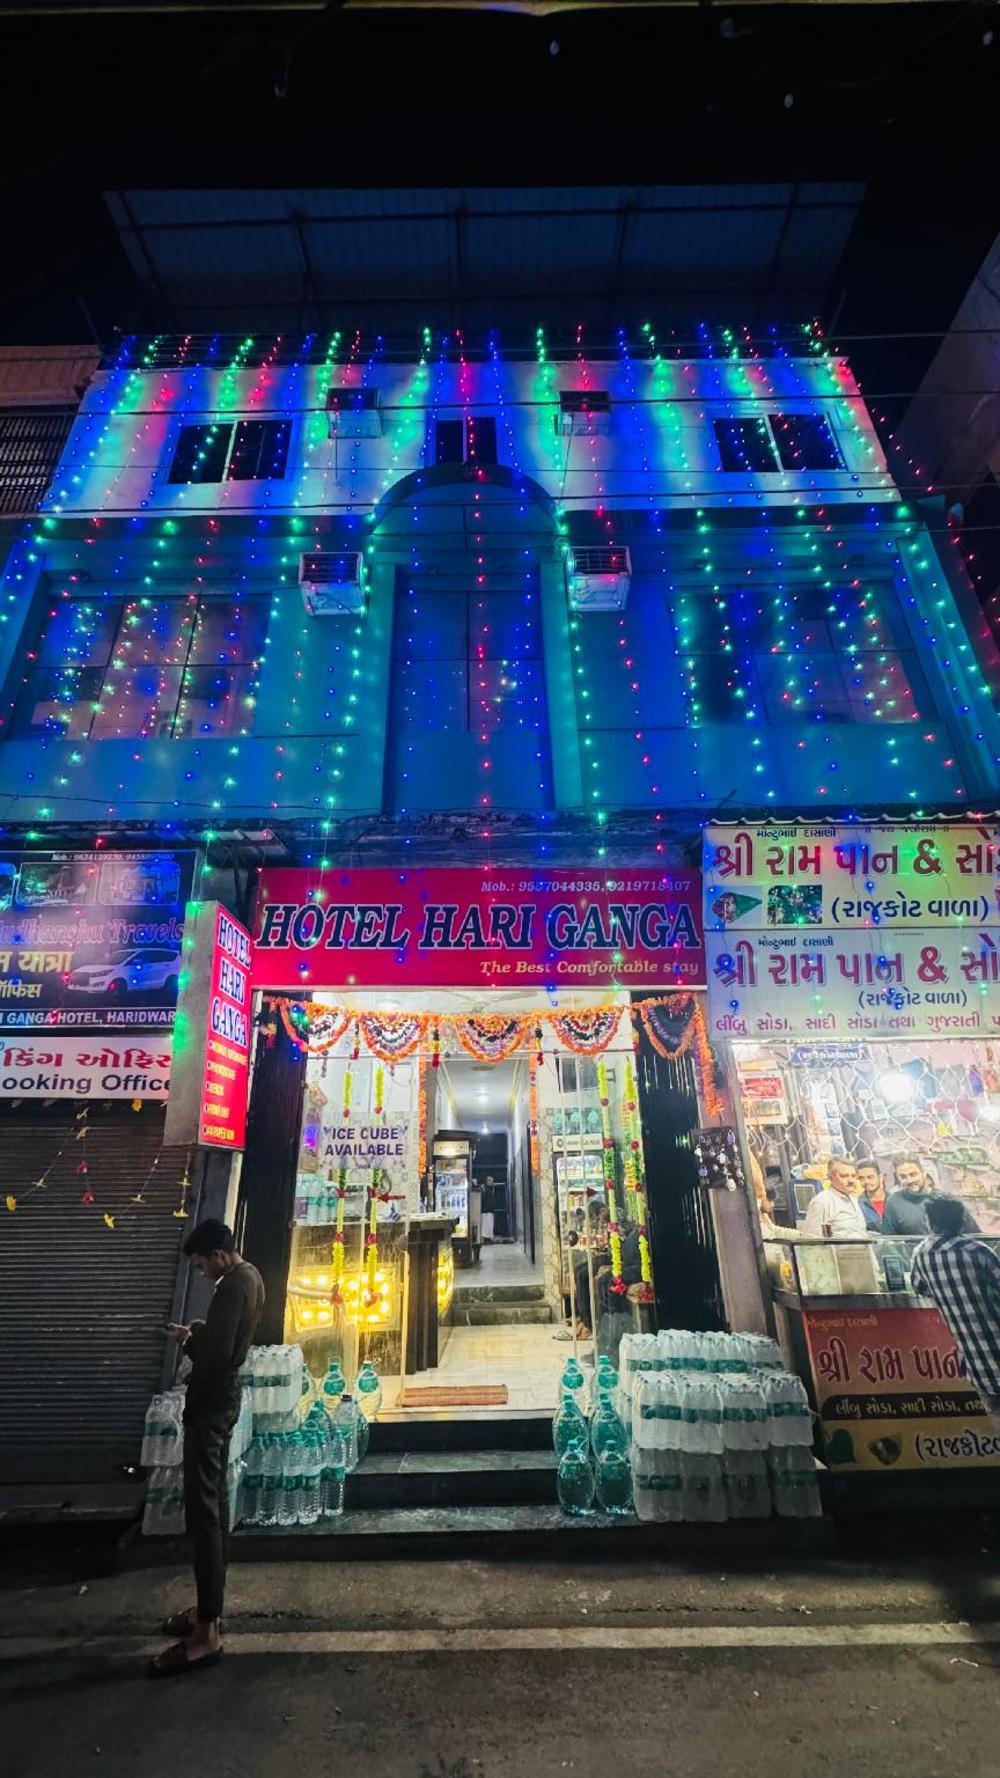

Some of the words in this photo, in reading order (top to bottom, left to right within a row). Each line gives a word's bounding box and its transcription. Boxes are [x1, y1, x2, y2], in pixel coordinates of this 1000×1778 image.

[714, 832, 753, 877] શ્રી
[766, 845, 821, 875] રામ
[833, 844, 898, 875] પાન
[913, 839, 941, 875] &
[481, 881, 515, 892] Mob.:
[928, 896, 989, 922] વાળા)
[0, 918, 104, 944] udhanshu
[255, 903, 410, 950] HOTEL
[418, 903, 537, 950] HARI
[546, 903, 701, 950] GANGA
[219, 912, 251, 970] HOTEL
[18, 951, 74, 973] यात्रा
[480, 961, 511, 974] The
[515, 961, 551, 974] Best
[556, 960, 658, 976] Comfortable
[713, 940, 757, 987] શ્રી
[768, 953, 826, 987] રામ
[836, 952, 904, 986] પાન
[917, 946, 949, 984] &
[219, 956, 247, 1006] HARI
[925, 989, 967, 1008] વાળા)
[6, 1012, 56, 1025] GANGA
[57, 1012, 103, 1025] HOTEL,
[212, 996, 248, 1048] GANGA
[757, 1012, 793, 1031] સોડા,
[805, 1013, 836, 1030] સાદી
[889, 1014, 916, 1029] તથા
[927, 1011, 980, 1034] ગુજરાતી
[3, 1047, 64, 1067] કિંગ
[2, 1073, 92, 1094] ooking
[332, 1127, 356, 1140] ICE
[360, 1127, 400, 1140] CUBE
[324, 1143, 404, 1156] AVAILABLE
[819, 1336, 850, 1383] શ્રી
[859, 1346, 904, 1384] રામ
[912, 1346, 967, 1381] પાન
